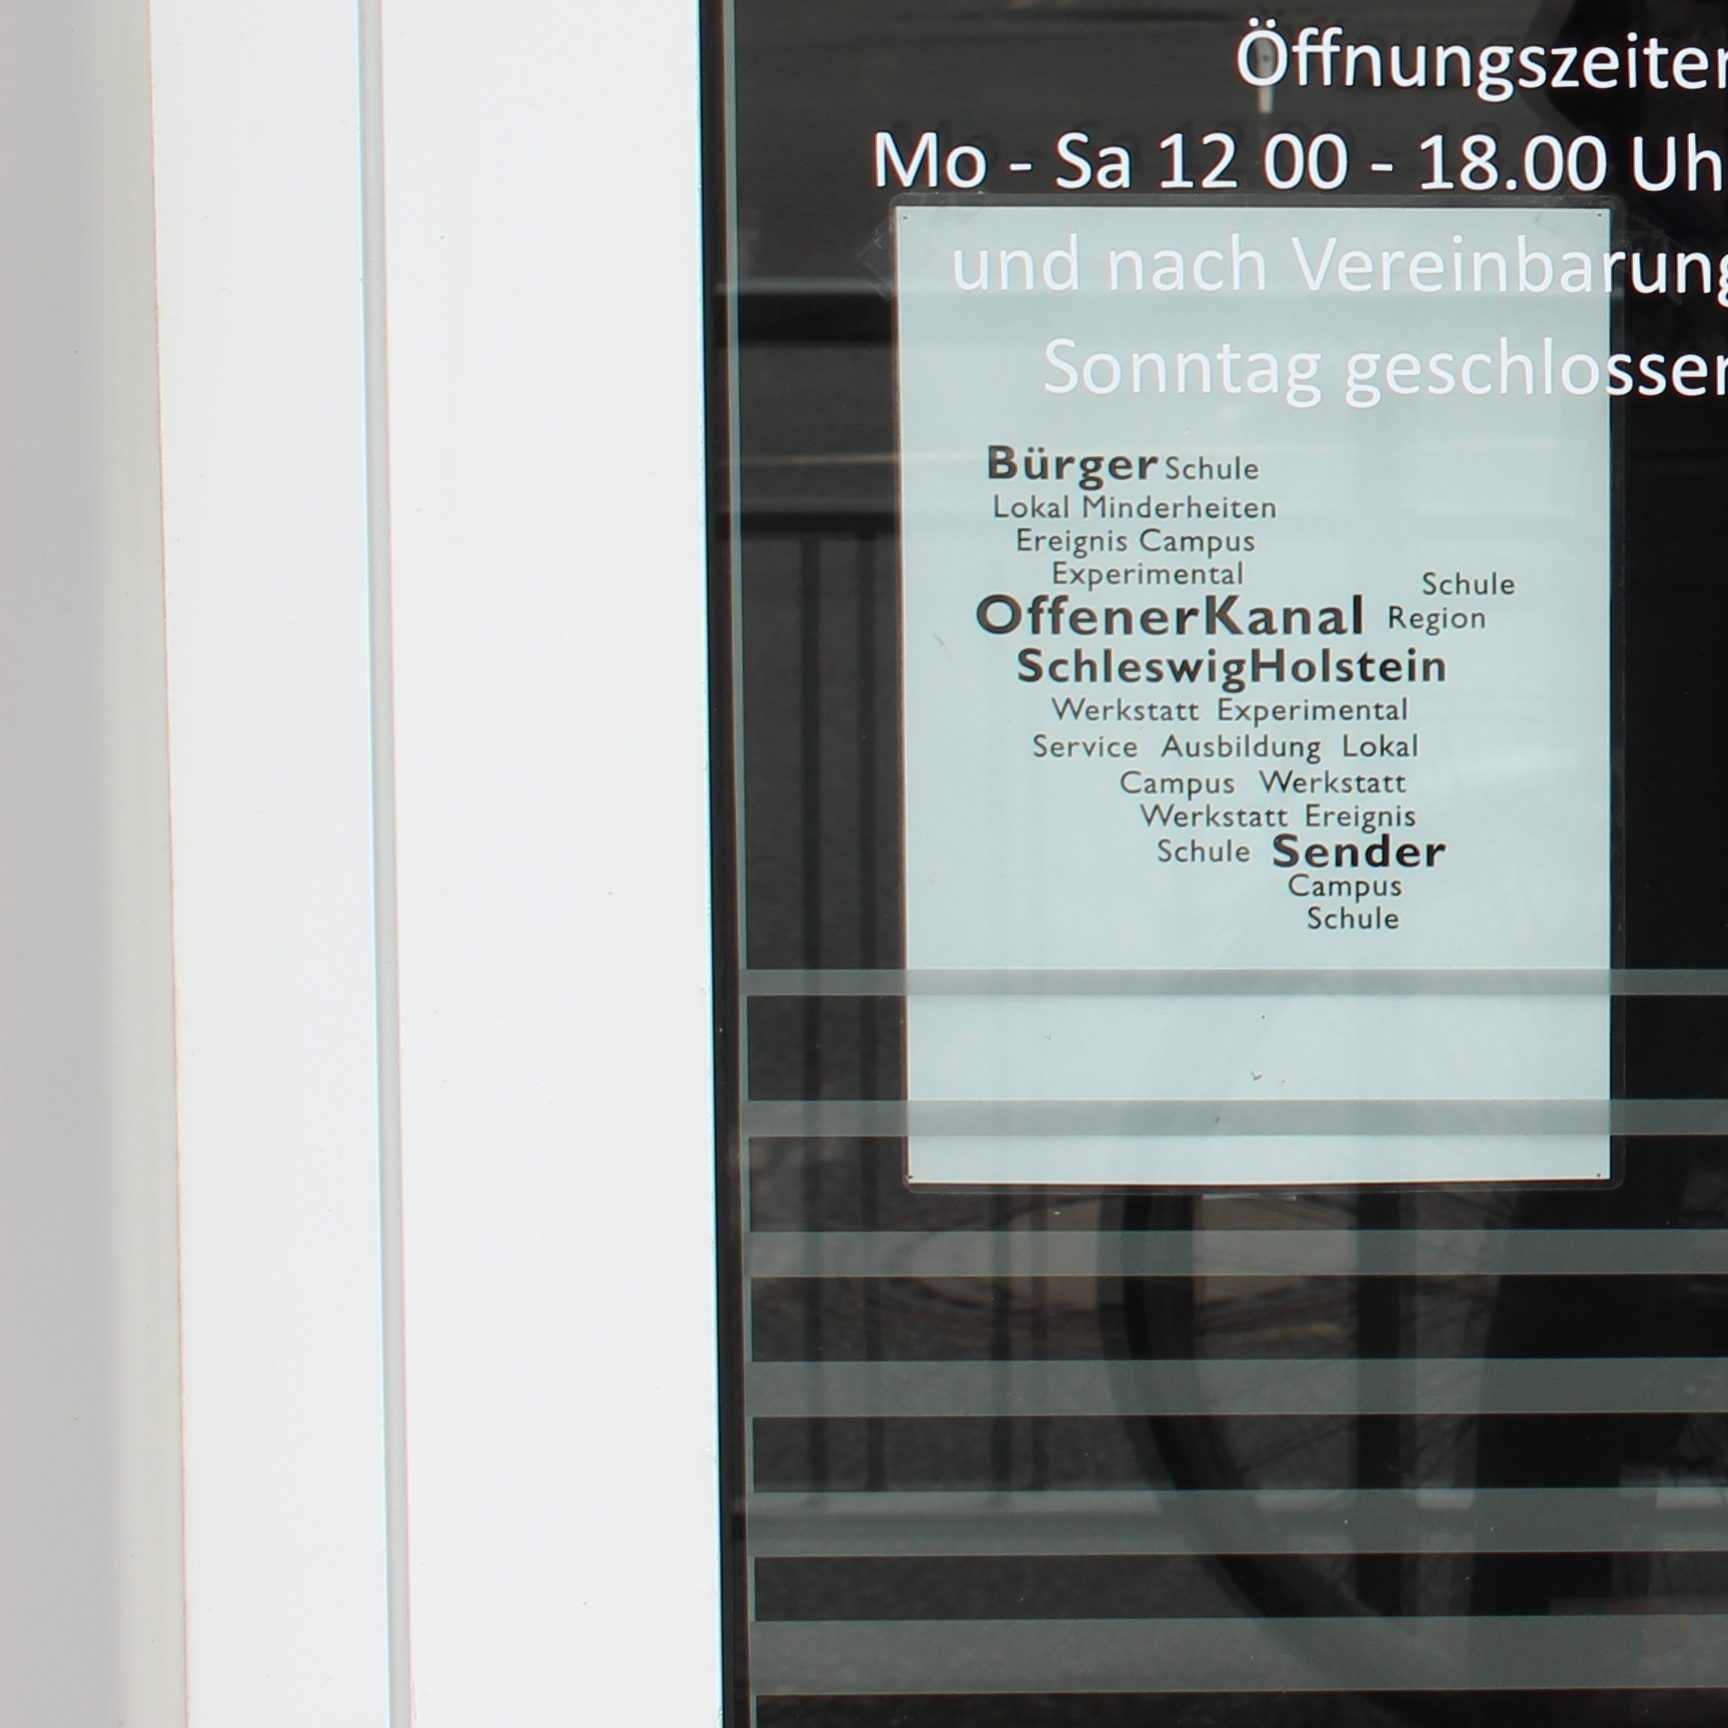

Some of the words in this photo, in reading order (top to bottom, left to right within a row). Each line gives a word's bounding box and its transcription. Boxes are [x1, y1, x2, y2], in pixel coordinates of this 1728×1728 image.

[876, 132, 985, 187] Mo
[1057, 133, 1129, 188] Sa
[1161, 133, 1237, 188] 12
[1265, 134, 1347, 189] 00
[1421, 135, 1606, 191] 18.00
[954, 233, 1078, 290] und
[1110, 233, 1265, 290] nach
[1045, 339, 1321, 407] Sonntag
[988, 445, 1158, 491] Bürger
[1166, 456, 1258, 479] Schule
[995, 495, 1068, 518] Lokal
[1084, 495, 1275, 518] Minderheiten
[1018, 528, 1127, 558] Ereignis
[1140, 528, 1254, 559] Campus
[1053, 561, 1242, 591] Experimental
[1423, 572, 1514, 595] Schule
[976, 594, 1362, 635] OffenerKanal
[1389, 606, 1485, 635] Region
[1018, 648, 1445, 693] SchleswigHolstein
[1052, 698, 1199, 721] Werkstatt
[1219, 697, 1406, 727] Experimental
[1034, 734, 1137, 757] Service
[1161, 735, 1320, 764] Ausbildung
[1344, 734, 1417, 757] Lokal
[1121, 771, 1234, 801] Campus
[1260, 770, 1405, 793] Werkstatt
[1140, 804, 1287, 827] Werkstatt
[1306, 804, 1415, 834] Ereignis
[1158, 839, 1249, 862] Schule
[1273, 834, 1445, 867] Sender
[1289, 874, 1401, 903] Campus
[1308, 906, 1398, 929] Schule
